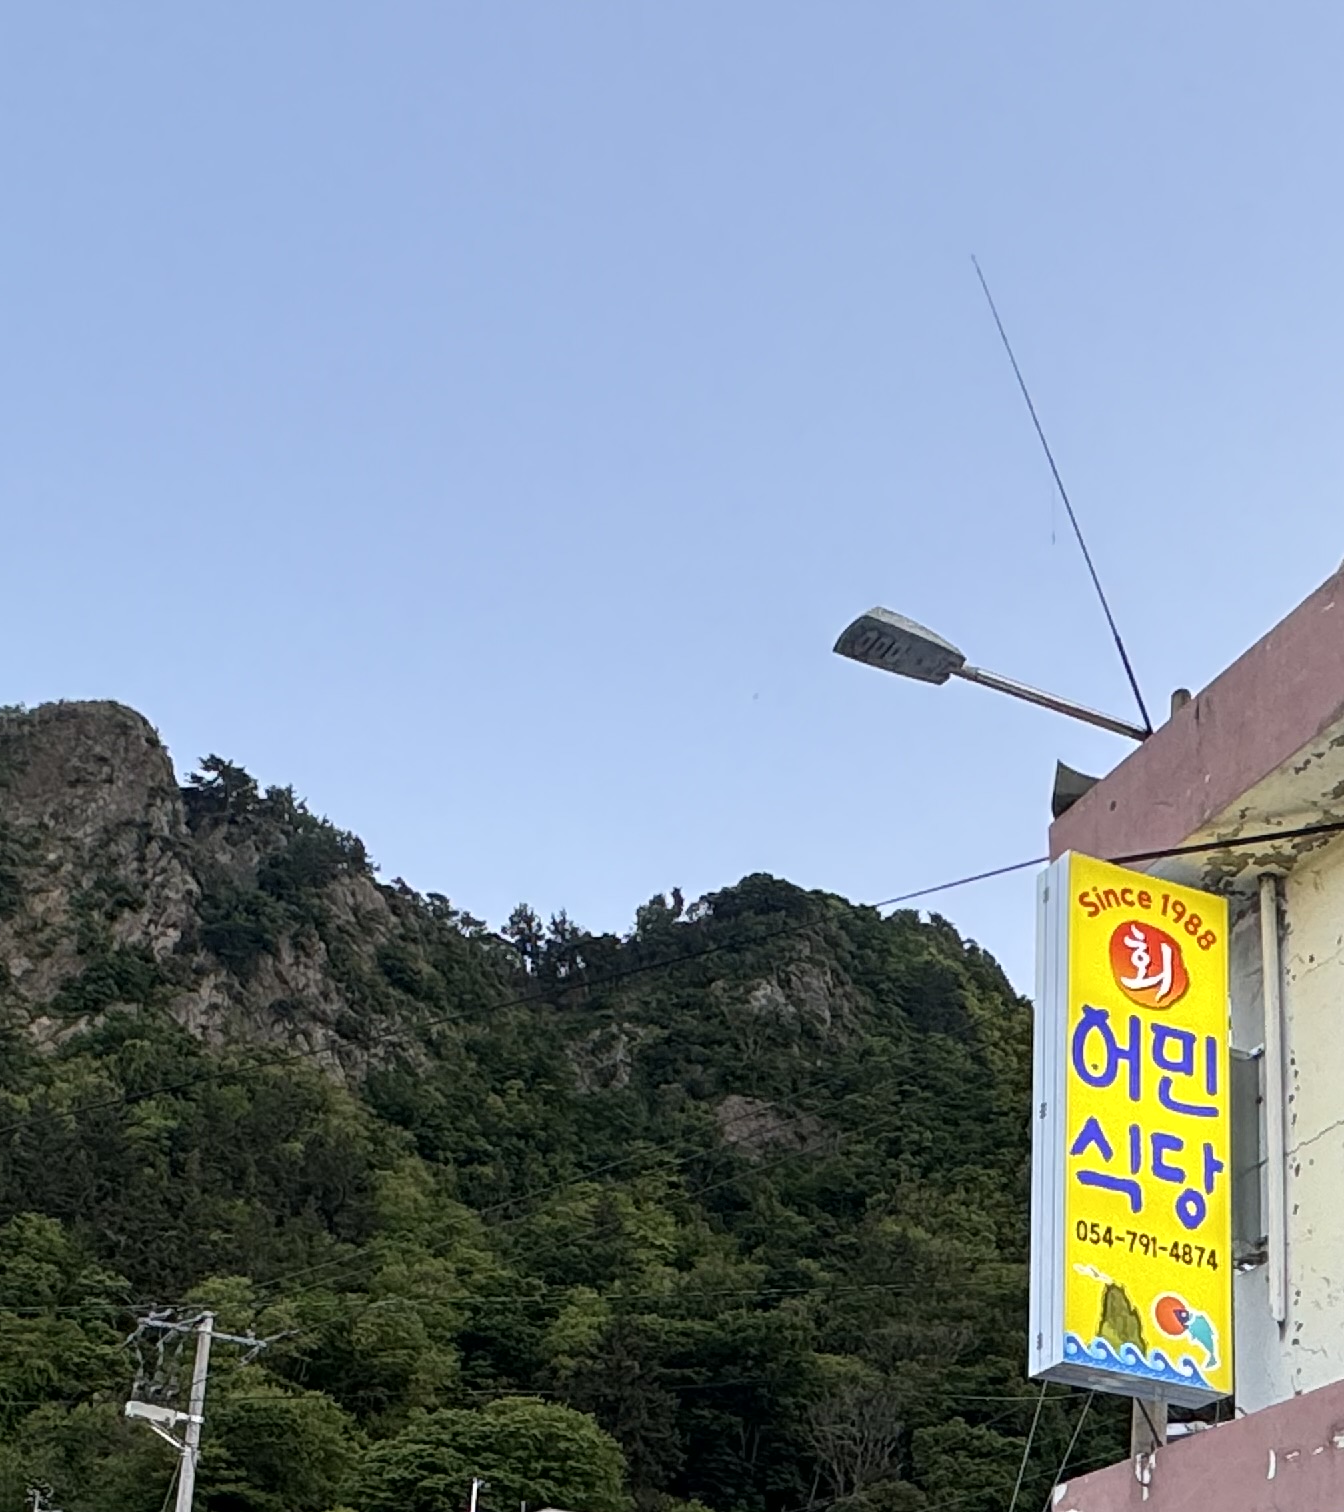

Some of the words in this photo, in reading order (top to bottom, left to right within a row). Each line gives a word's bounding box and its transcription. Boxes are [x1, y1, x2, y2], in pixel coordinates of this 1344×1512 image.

[1078, 885, 1153, 919] Since
[1160, 893, 1218, 952] 1988
[1119, 922, 1174, 1003] 회
[1072, 1004, 1220, 1118] 어민
[1069, 1115, 1224, 1230] 식당
[1075, 1218, 1219, 1271] 054-791-4874
